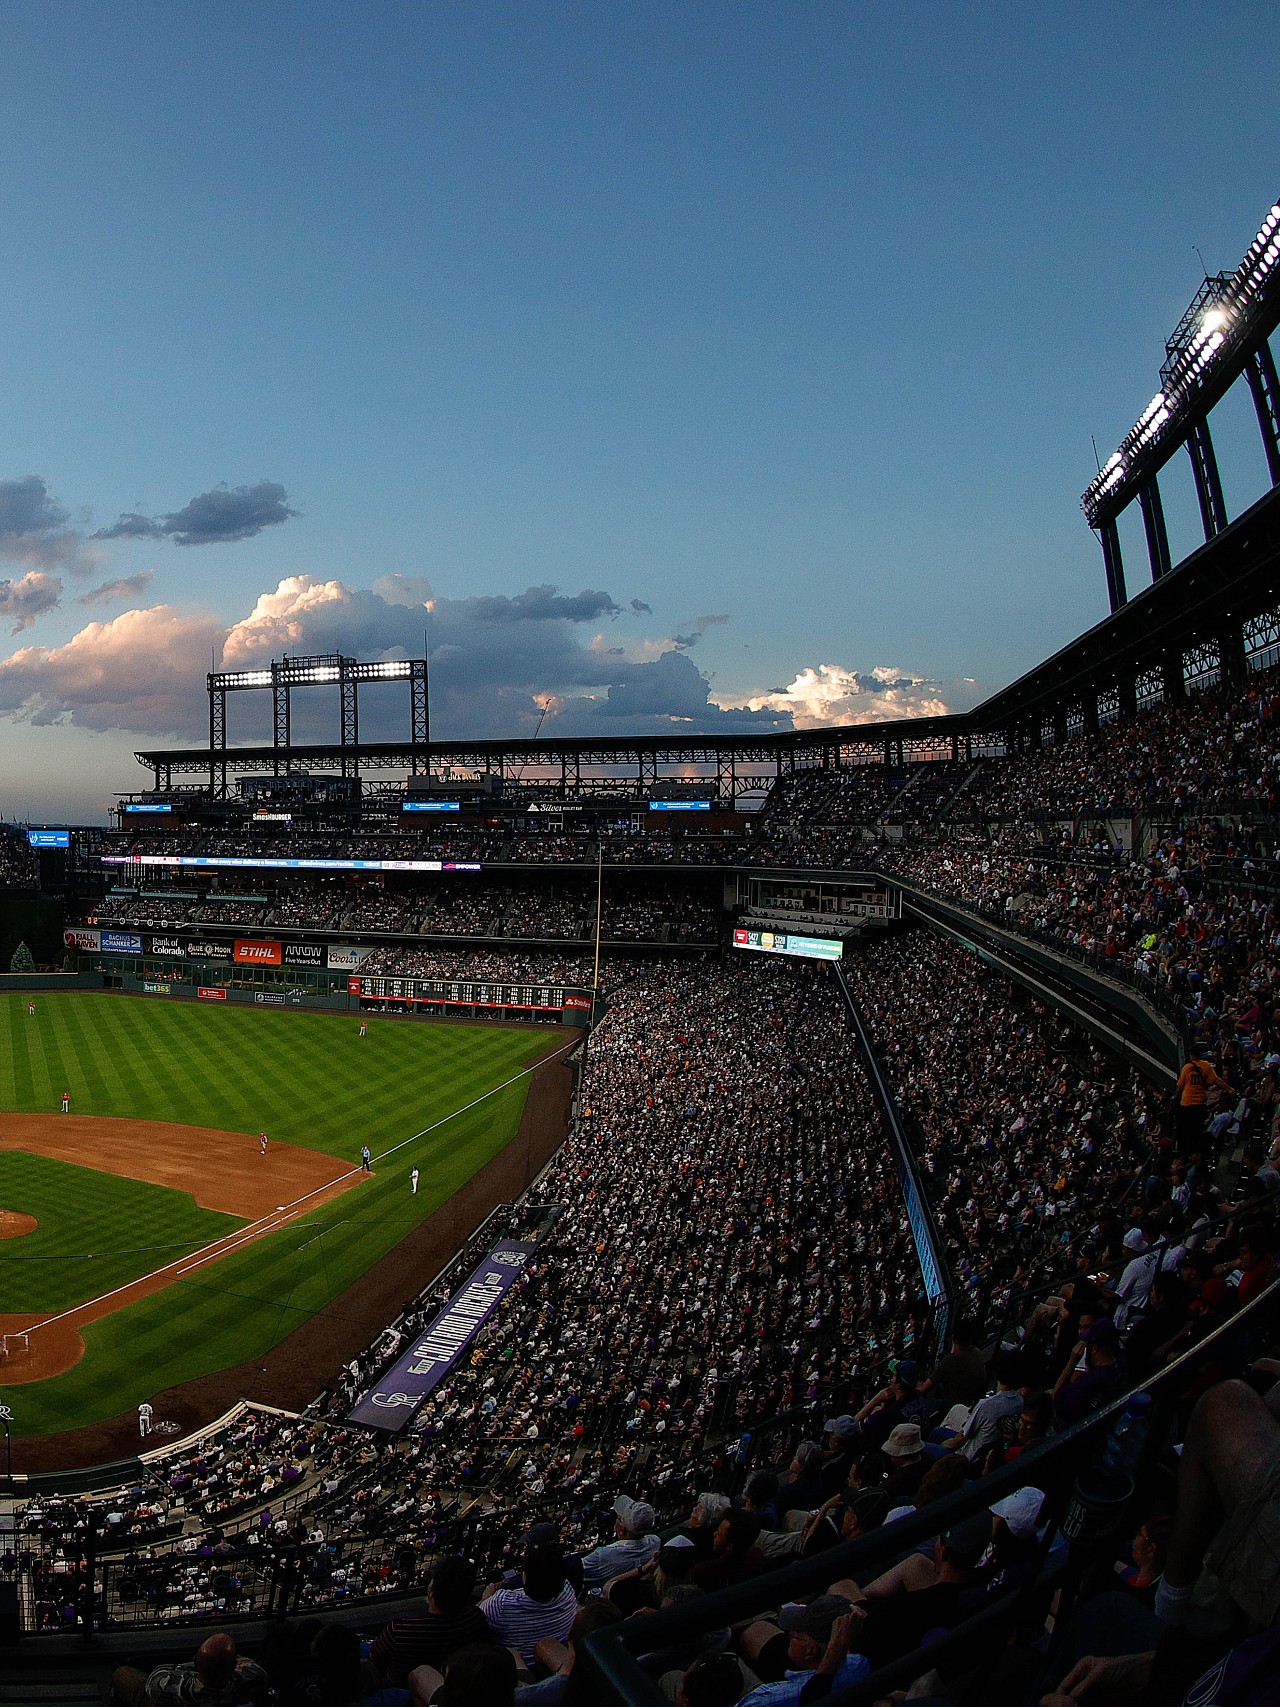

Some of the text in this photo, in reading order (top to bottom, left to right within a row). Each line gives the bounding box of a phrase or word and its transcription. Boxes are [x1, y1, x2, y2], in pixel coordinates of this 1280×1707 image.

[102, 939, 130, 947] SCHANKER
[153, 937, 179, 946] Bank of
[152, 946, 185, 956] Colorado
[187, 943, 203, 952] BLUE
[239, 946, 275, 958] STIHL
[329, 952, 353, 963] Coors
[144, 983, 170, 993] bet365
[413, 1282, 504, 1362] COLORADO ROCKIES
